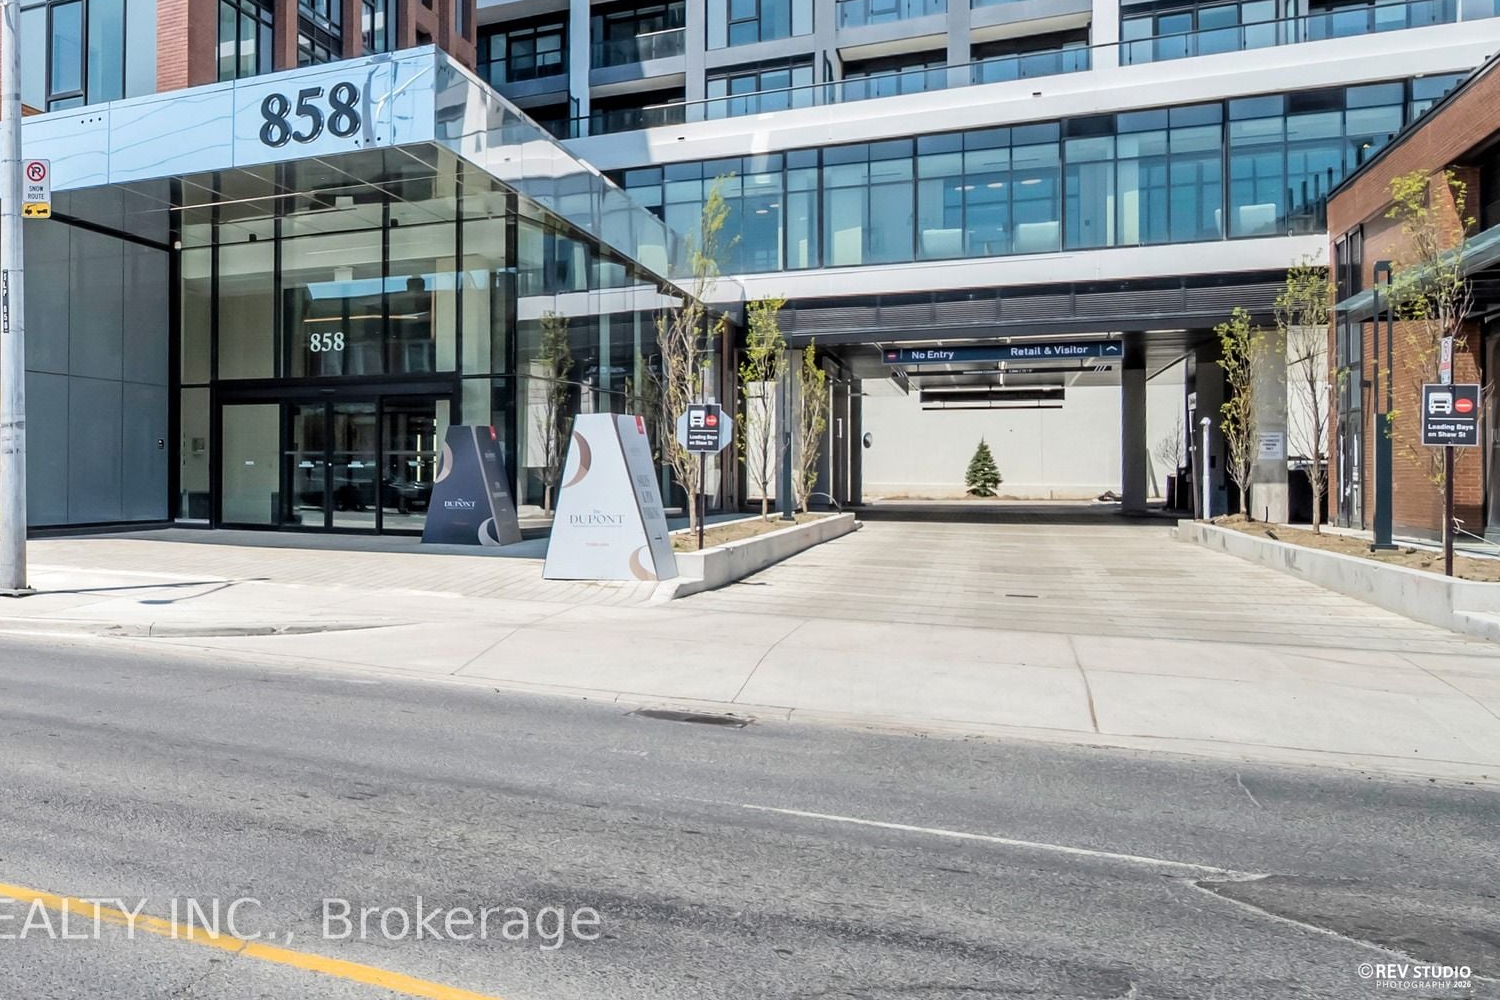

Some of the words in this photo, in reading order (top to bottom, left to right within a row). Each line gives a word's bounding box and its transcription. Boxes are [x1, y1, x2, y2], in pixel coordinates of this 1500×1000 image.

[260, 82, 361, 148] 858
[310, 331, 345, 352] 858
[911, 351, 925, 359] No
[927, 350, 954, 360] Entry
[1010, 346, 1041, 356] Retail
[1044, 346, 1052, 355] &
[1054, 345, 1089, 355] Visitor
[1456, 423, 1474, 431] Bays
[444, 500, 476, 508] DUPONT
[569, 513, 626, 525] DUPONT
